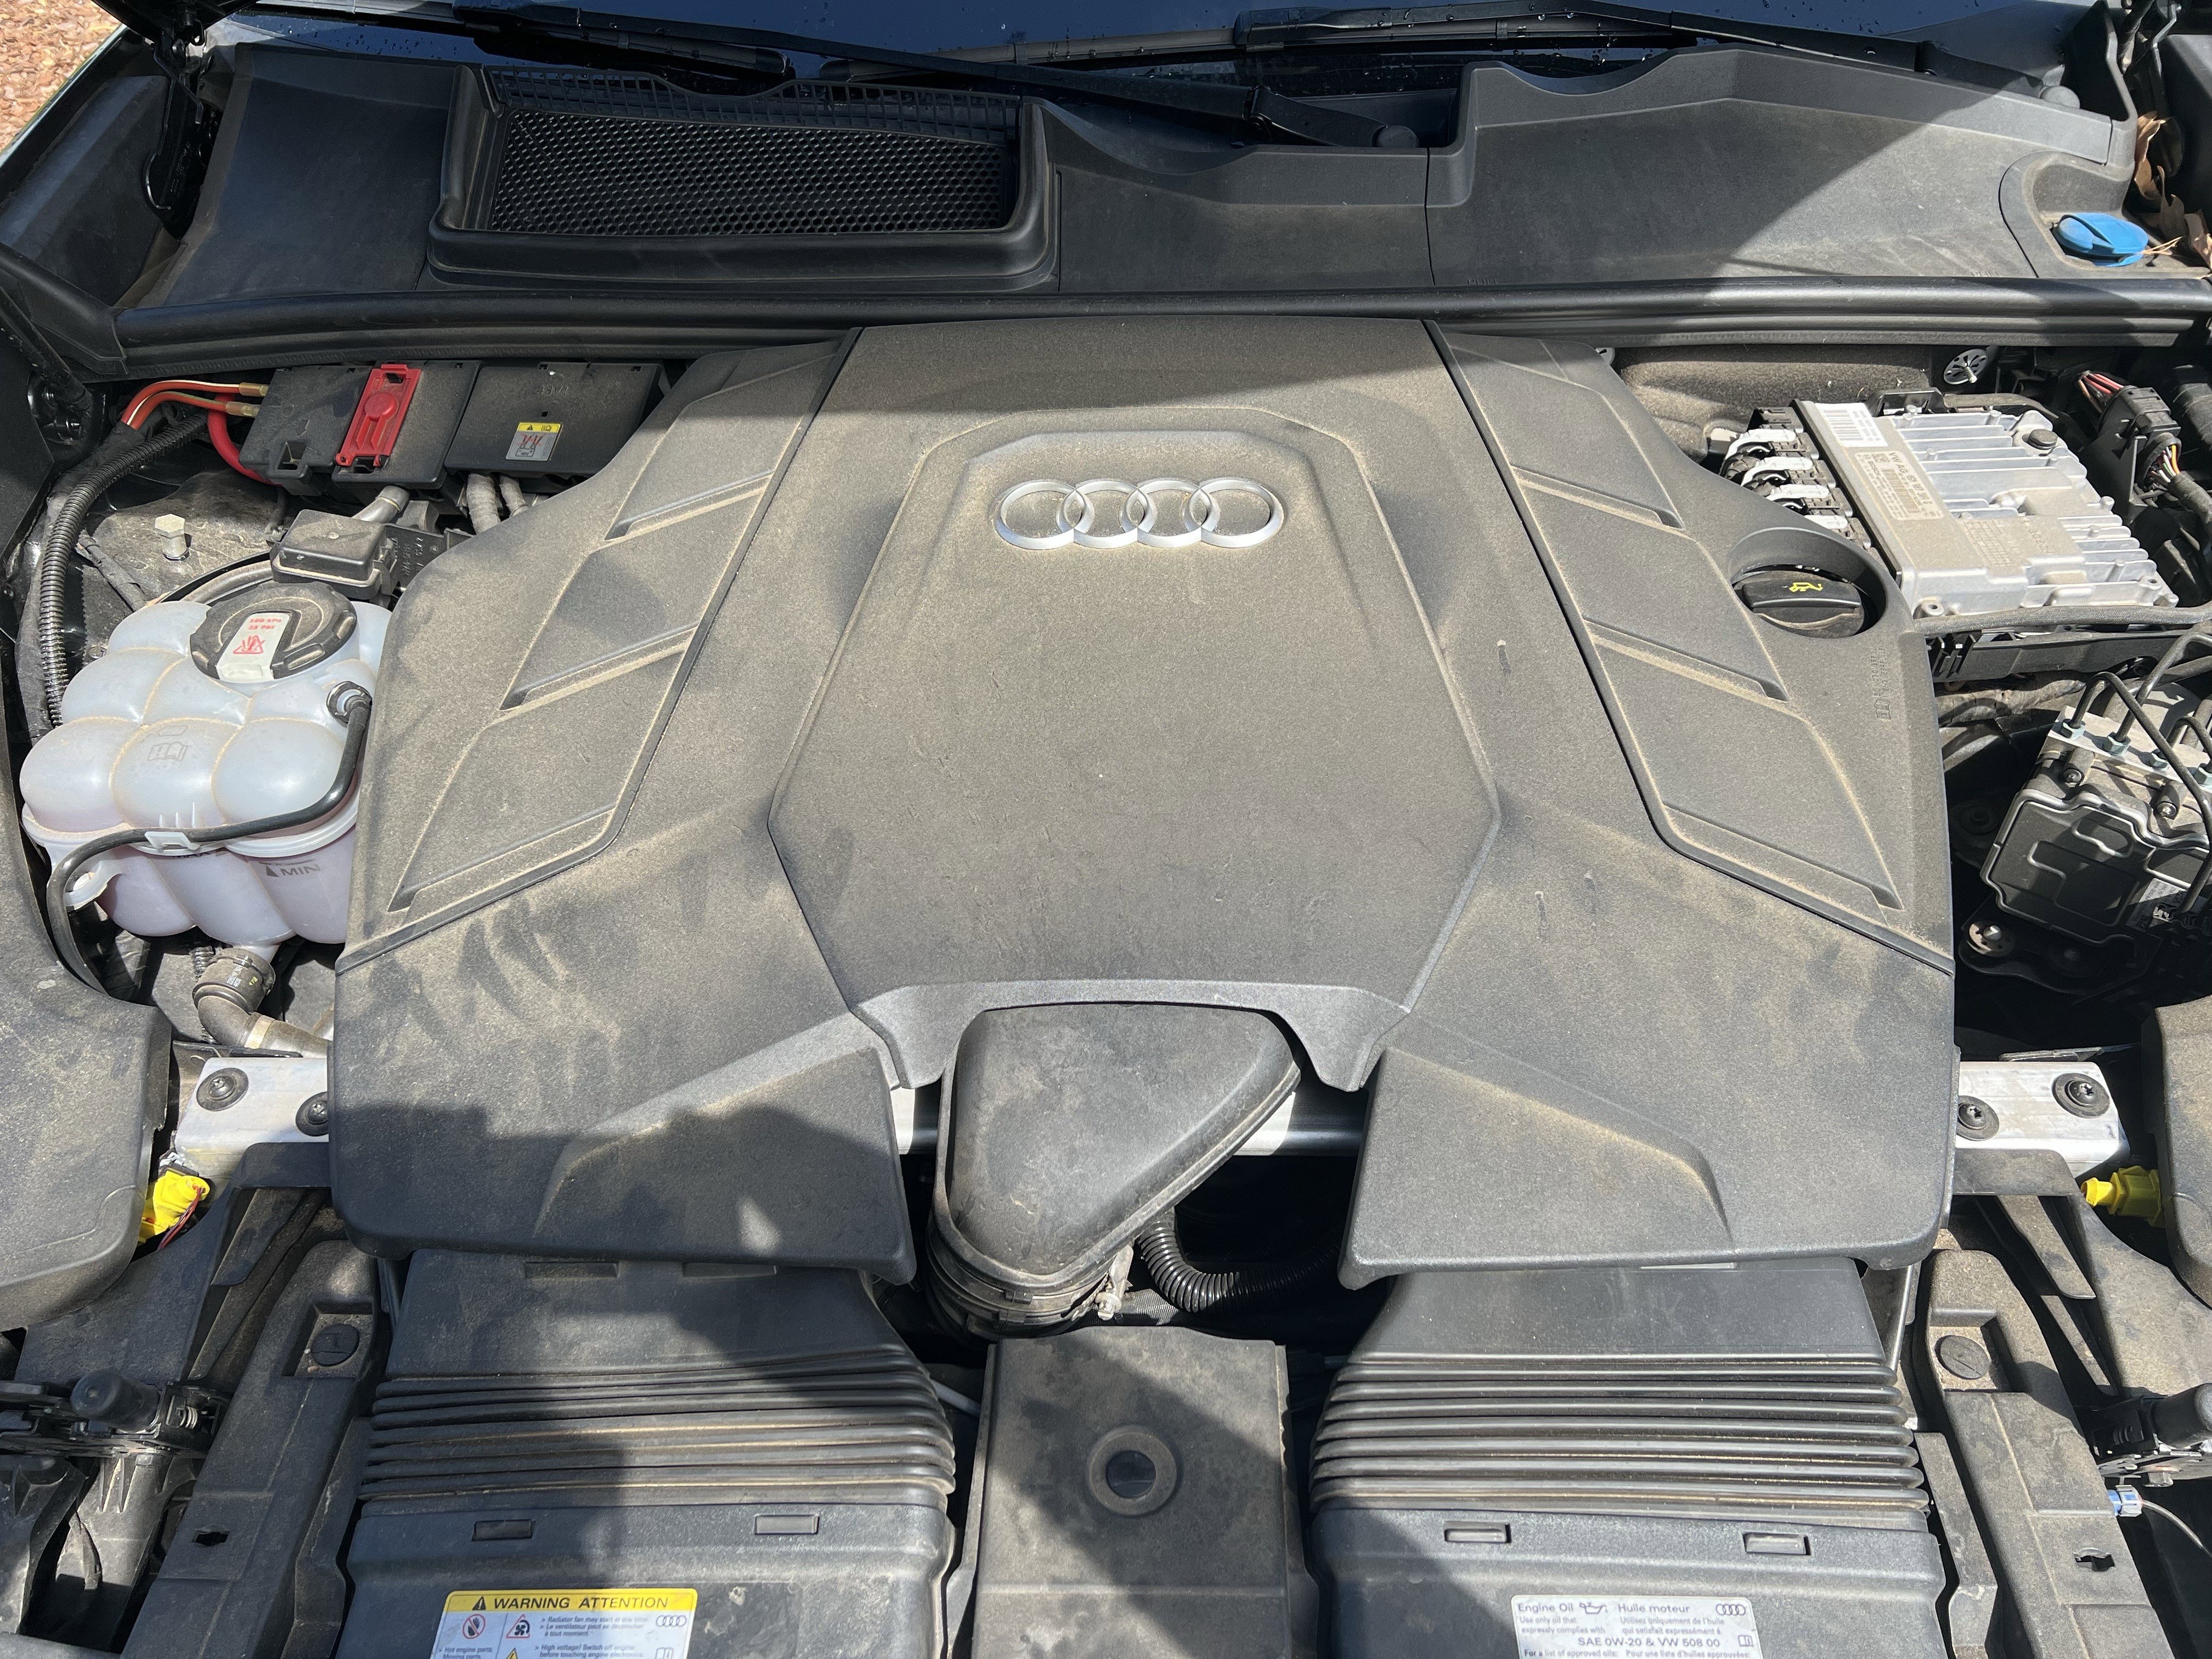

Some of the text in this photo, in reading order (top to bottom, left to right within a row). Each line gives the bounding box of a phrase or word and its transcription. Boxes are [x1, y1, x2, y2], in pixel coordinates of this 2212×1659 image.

[280, 864, 320, 876] MIN
[494, 1597, 668, 1609] WARNING ATTENTION
[1518, 1602, 1573, 1613] Engine Oil
[1618, 1603, 1645, 1612] Huile
[1535, 1616, 1550, 1624] only
[1552, 1615, 1561, 1623] oil
[1620, 1616, 1646, 1624] Utilisez
[1648, 1616, 1691, 1626] uniquement
[1521, 1626, 1554, 1635] expressly
[1556, 1626, 1588, 1635] complies
[1622, 1627, 1634, 1635] qui
[1635, 1626, 1663, 1634] satisfait
[1578, 1637, 1721, 1647] SAE 0W-20 & VW 508 00
[1567, 1649, 1601, 1658] approved
[1626, 1649, 1643, 1657] Pour
